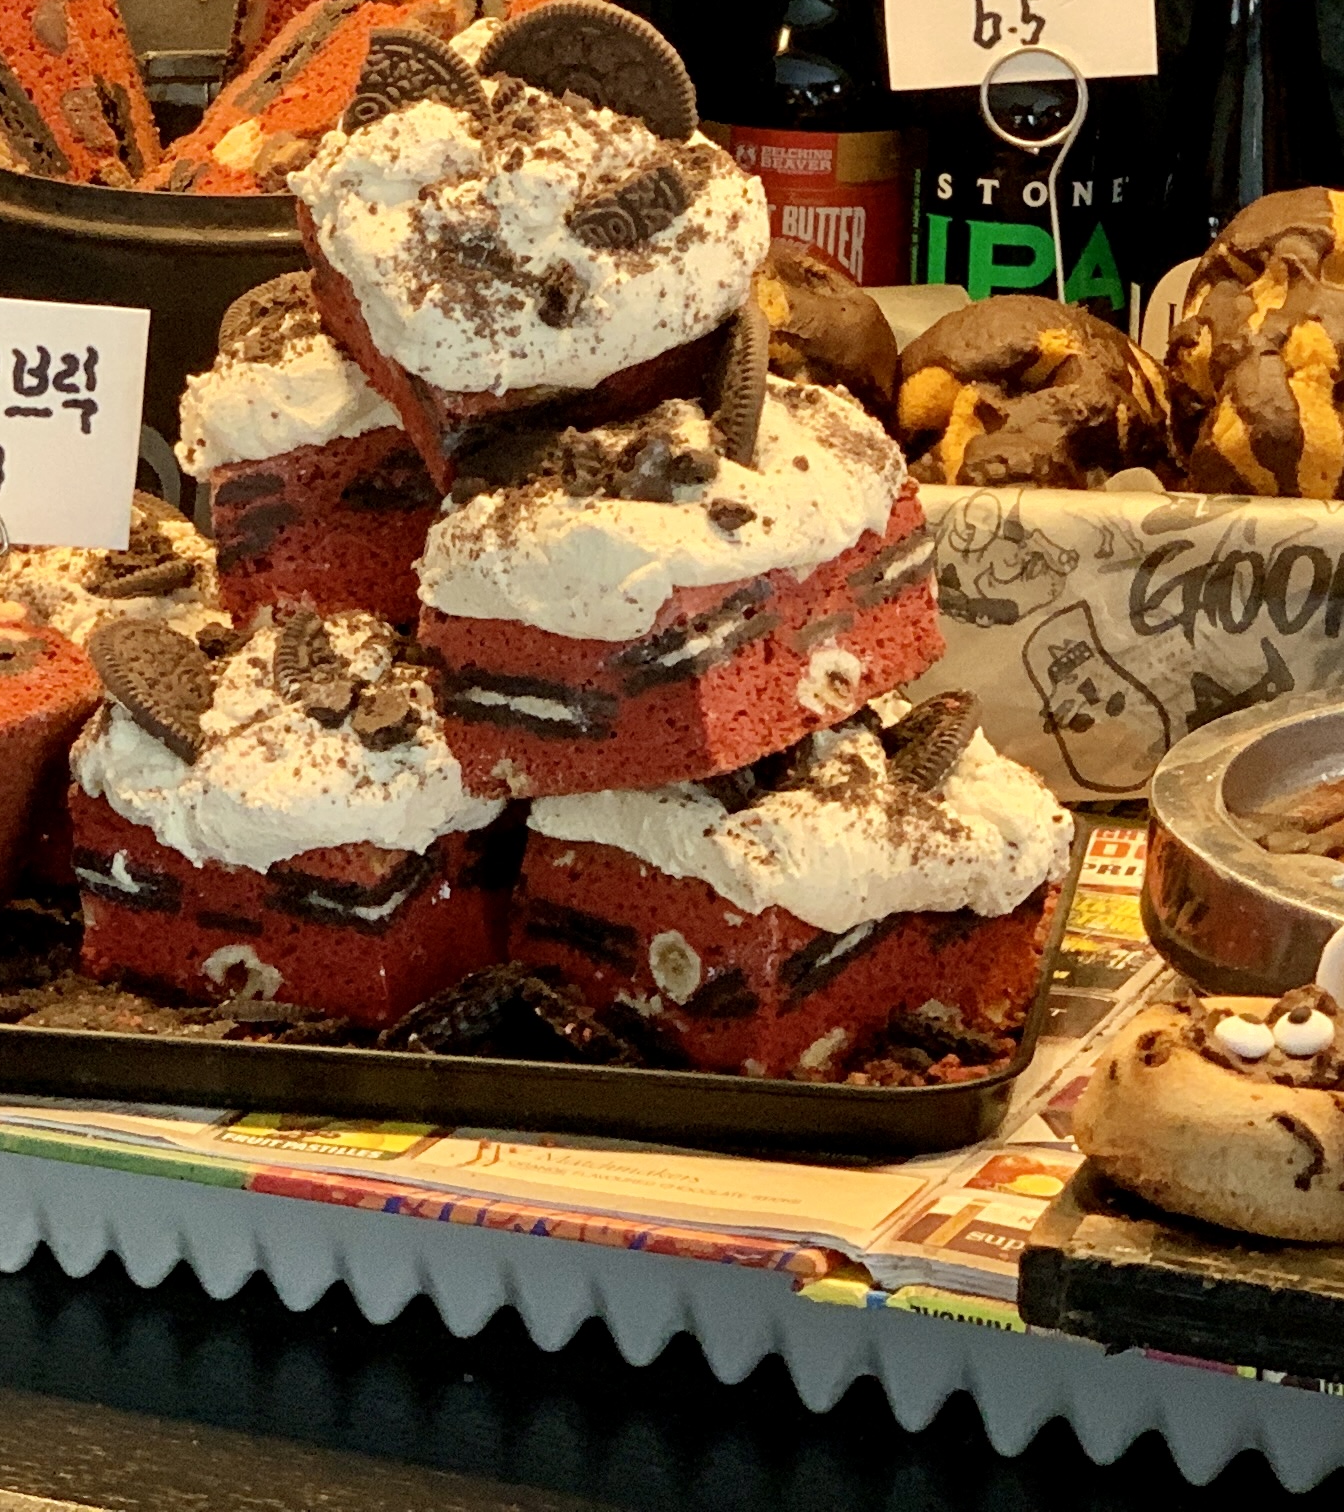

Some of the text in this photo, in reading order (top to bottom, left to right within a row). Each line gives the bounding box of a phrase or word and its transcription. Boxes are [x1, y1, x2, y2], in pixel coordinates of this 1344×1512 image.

[761, 146, 832, 159] BELCHING
[761, 158, 831, 171] BEAVER
[937, 172, 1124, 207] STONE
[782, 205, 866, 285] BUTTER
[927, 213, 1126, 312] IPA
[221, 1132, 283, 1147] FRUIT
[282, 1140, 384, 1159] PASTILLES
